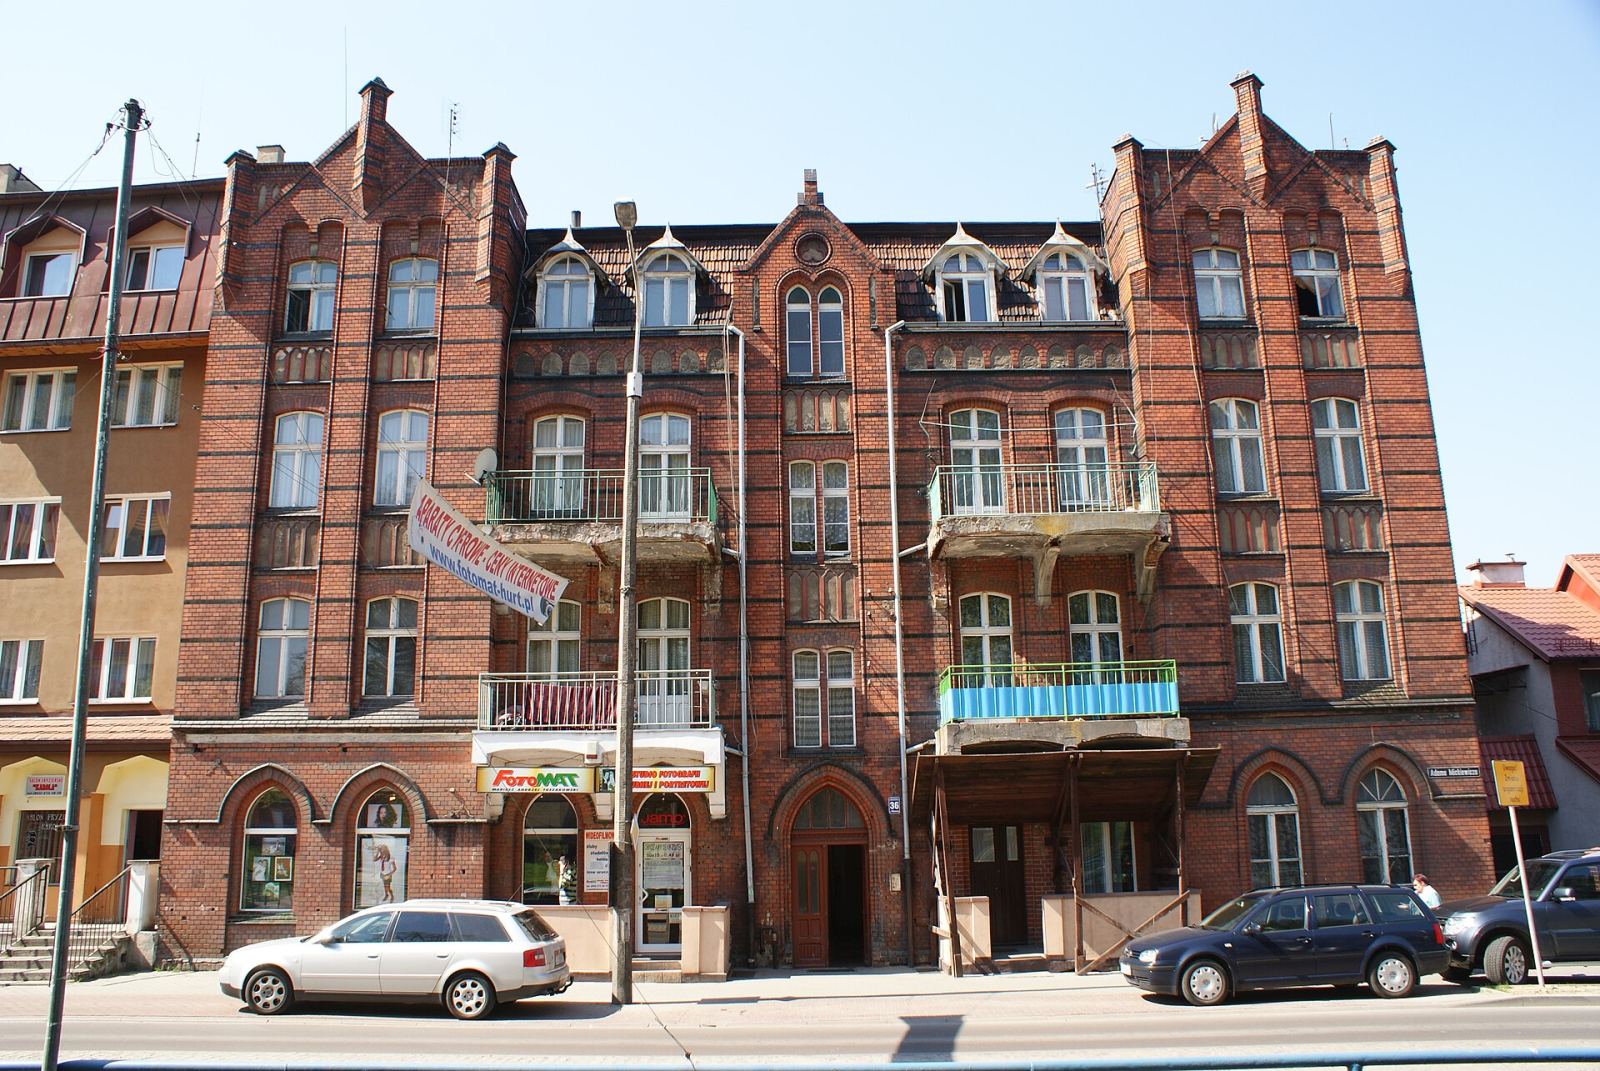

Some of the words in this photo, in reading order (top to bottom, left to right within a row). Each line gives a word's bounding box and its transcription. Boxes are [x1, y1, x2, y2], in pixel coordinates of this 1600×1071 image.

[416, 494, 455, 542] APARATY
[485, 550, 513, 578] CENY
[505, 560, 559, 600] INTERNETOWE
[430, 544, 534, 613] www.fotomat-hurt.pl
[1430, 769, 1447, 777] Adama
[1448, 768, 1479, 776] Mickiewicza
[659, 780, 710, 789] PORTRETOWEJ
[889, 801, 899, 810] 36
